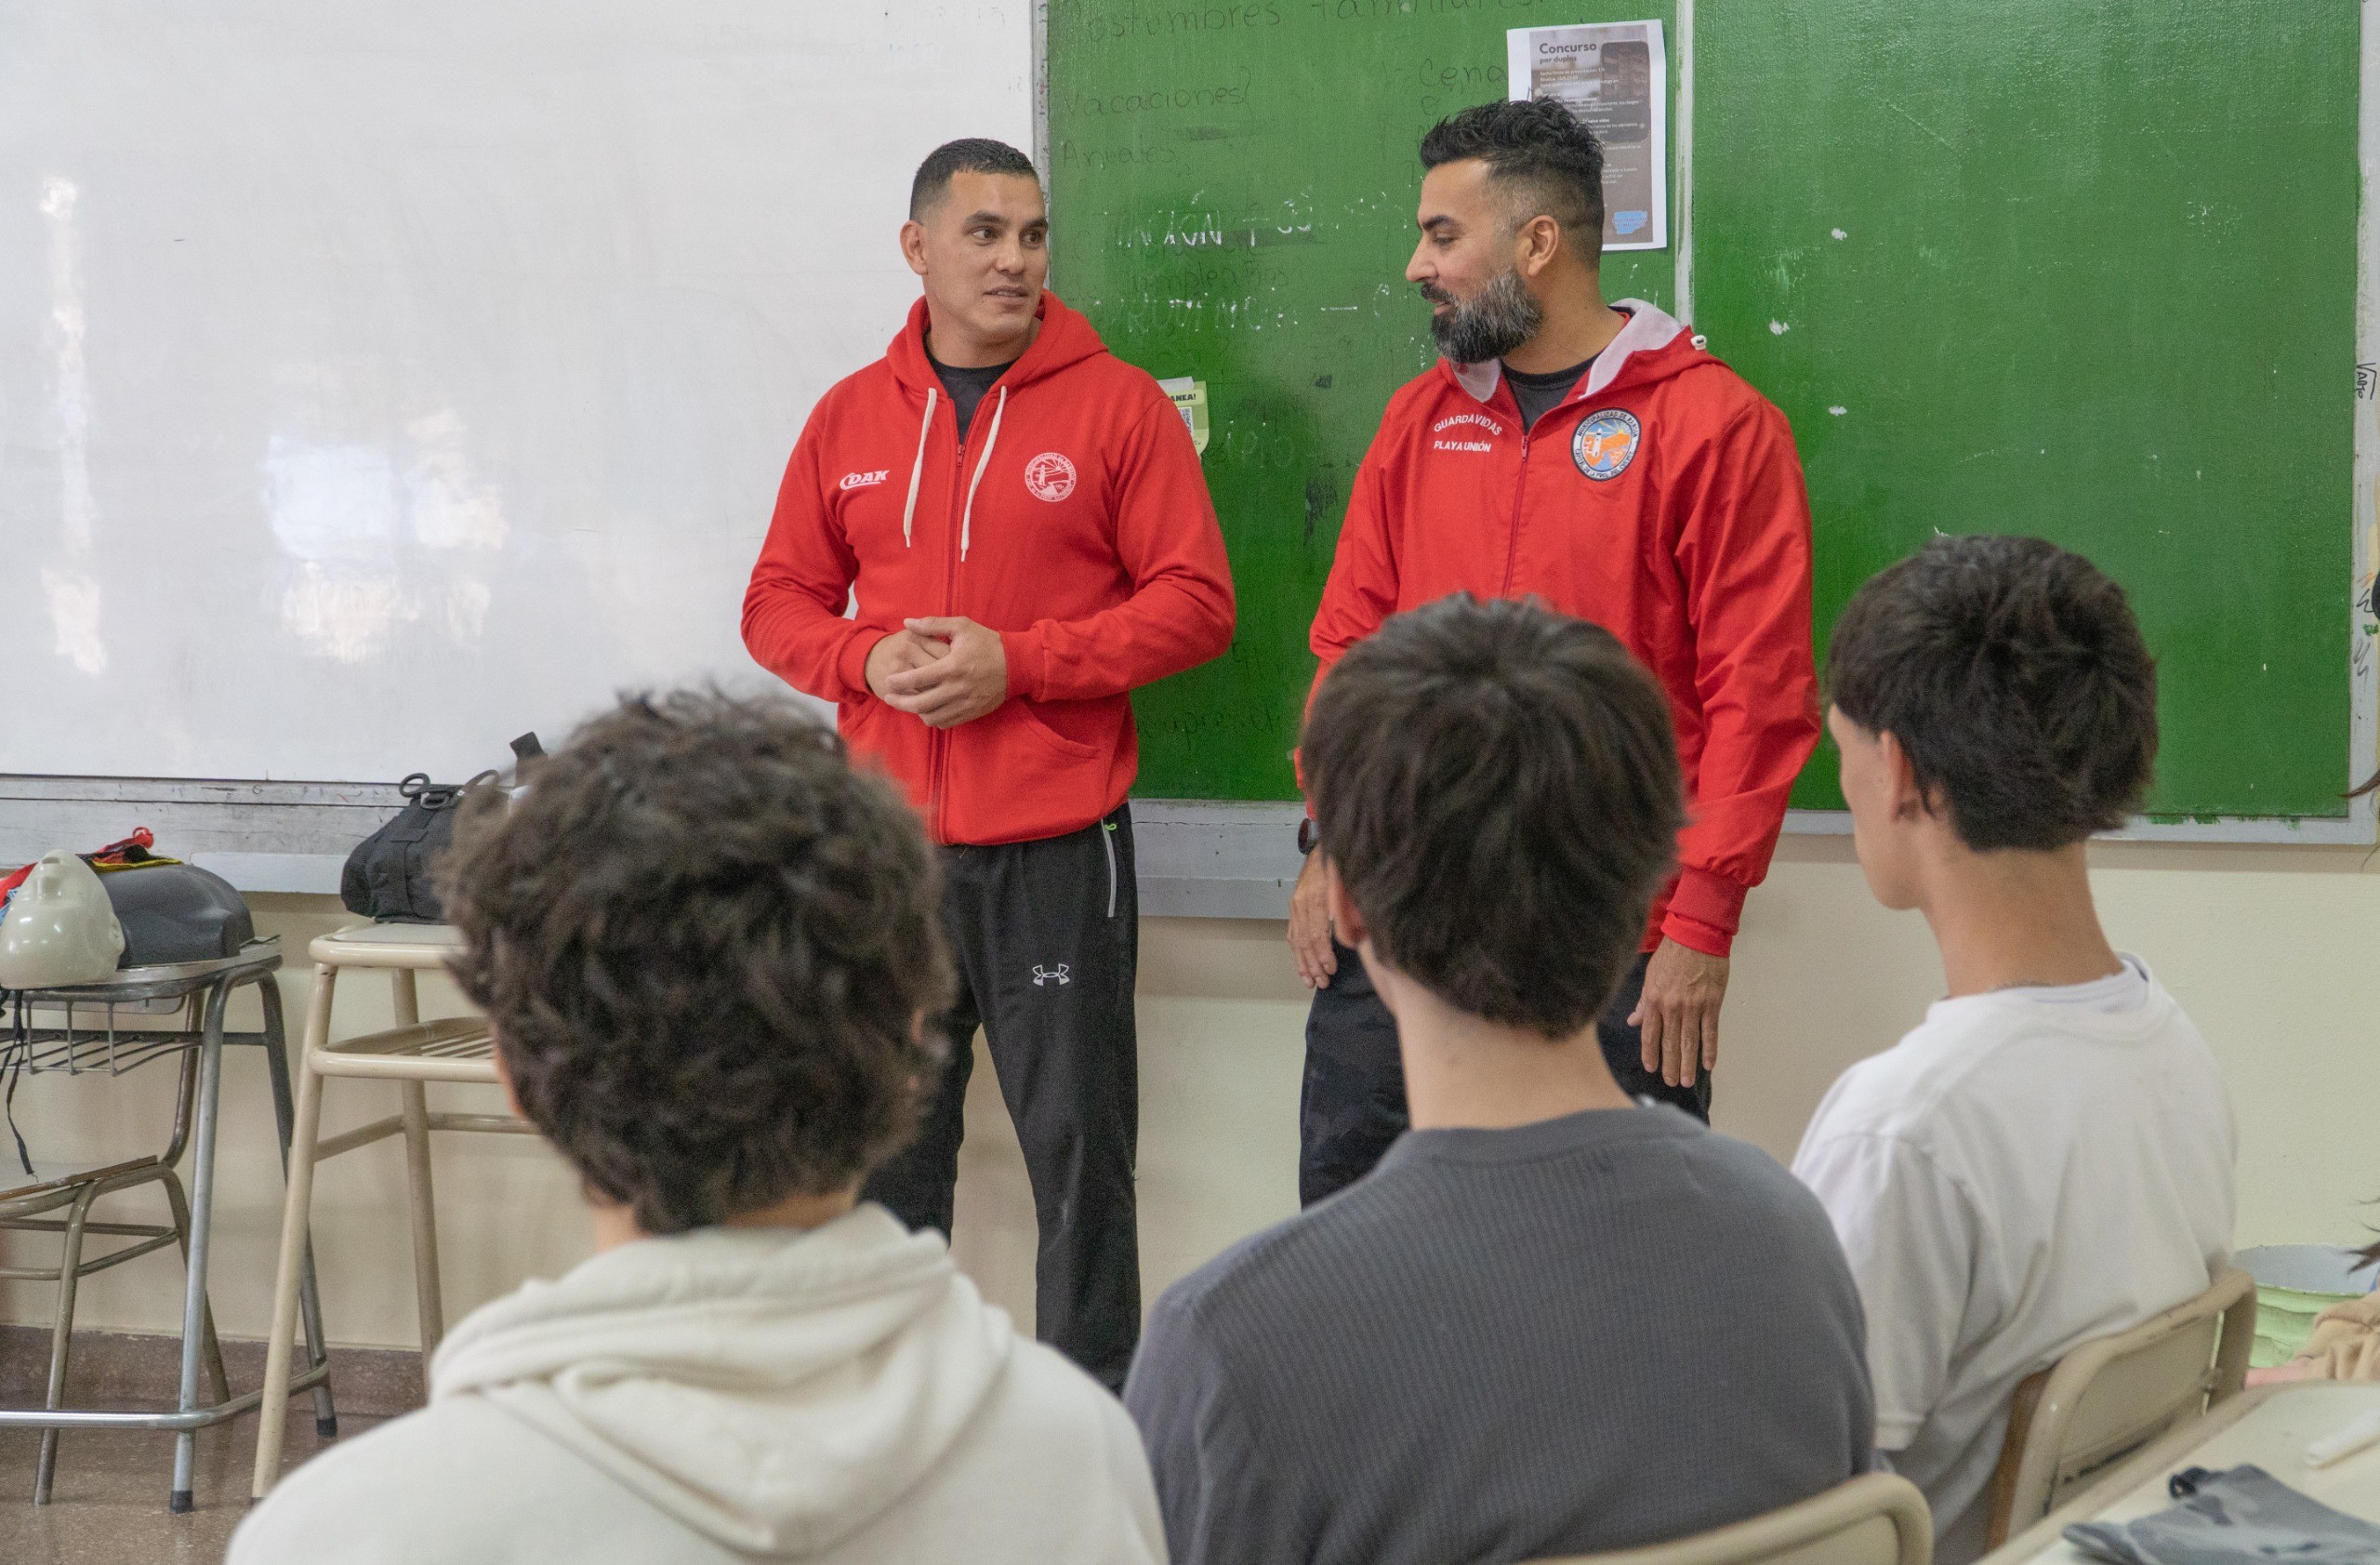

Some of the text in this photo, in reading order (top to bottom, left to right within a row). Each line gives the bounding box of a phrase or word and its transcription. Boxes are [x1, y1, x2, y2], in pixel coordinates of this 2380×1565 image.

[1068, 0, 1281, 43] ostumbres
[1539, 43, 1597, 54] Concurso
[1434, 414, 1503, 436] GUARDAVIDAS
[1434, 439, 1492, 453] PLAYA UNIÓN
